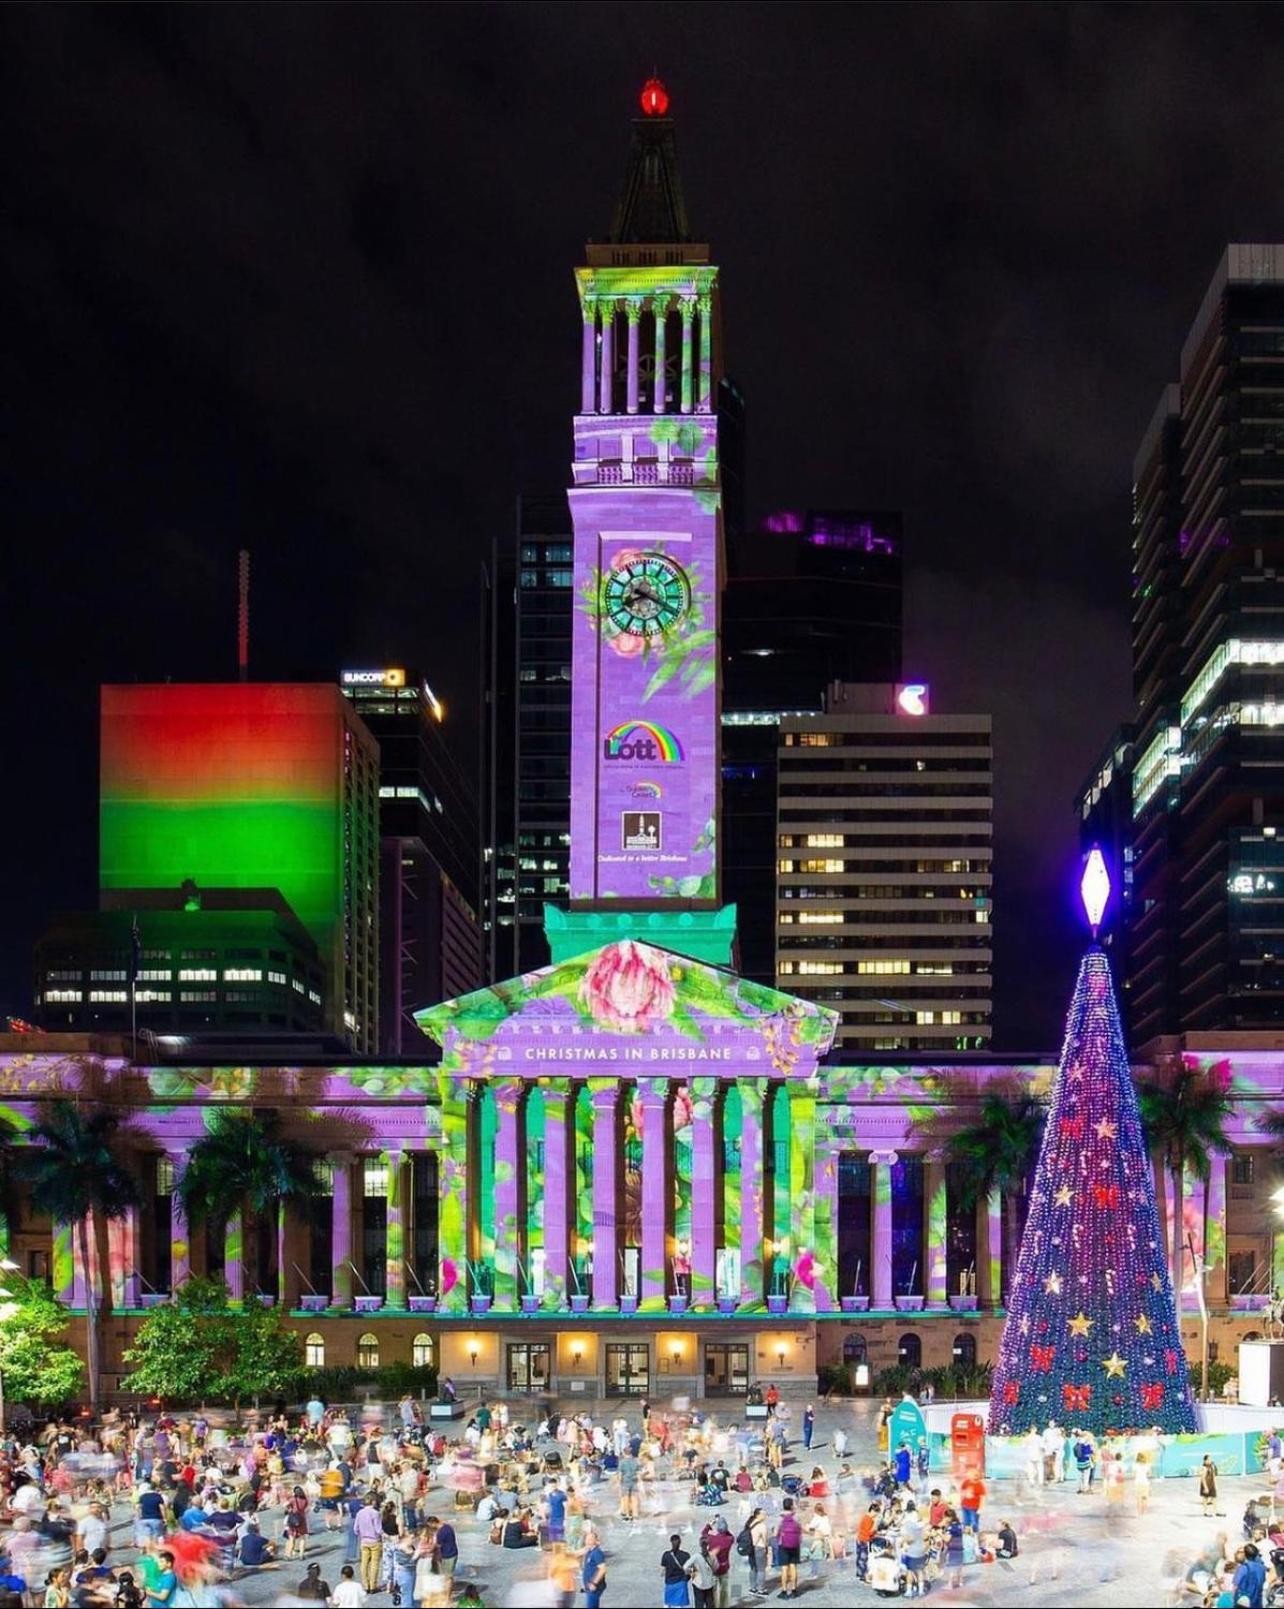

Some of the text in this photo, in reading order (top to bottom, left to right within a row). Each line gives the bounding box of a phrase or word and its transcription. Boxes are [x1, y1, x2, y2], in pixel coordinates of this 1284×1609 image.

[344, 672, 386, 682] SUNCORP
[604, 739, 656, 761] Lott
[525, 1048, 731, 1060] CHRISTMAS IN BRISBANE
